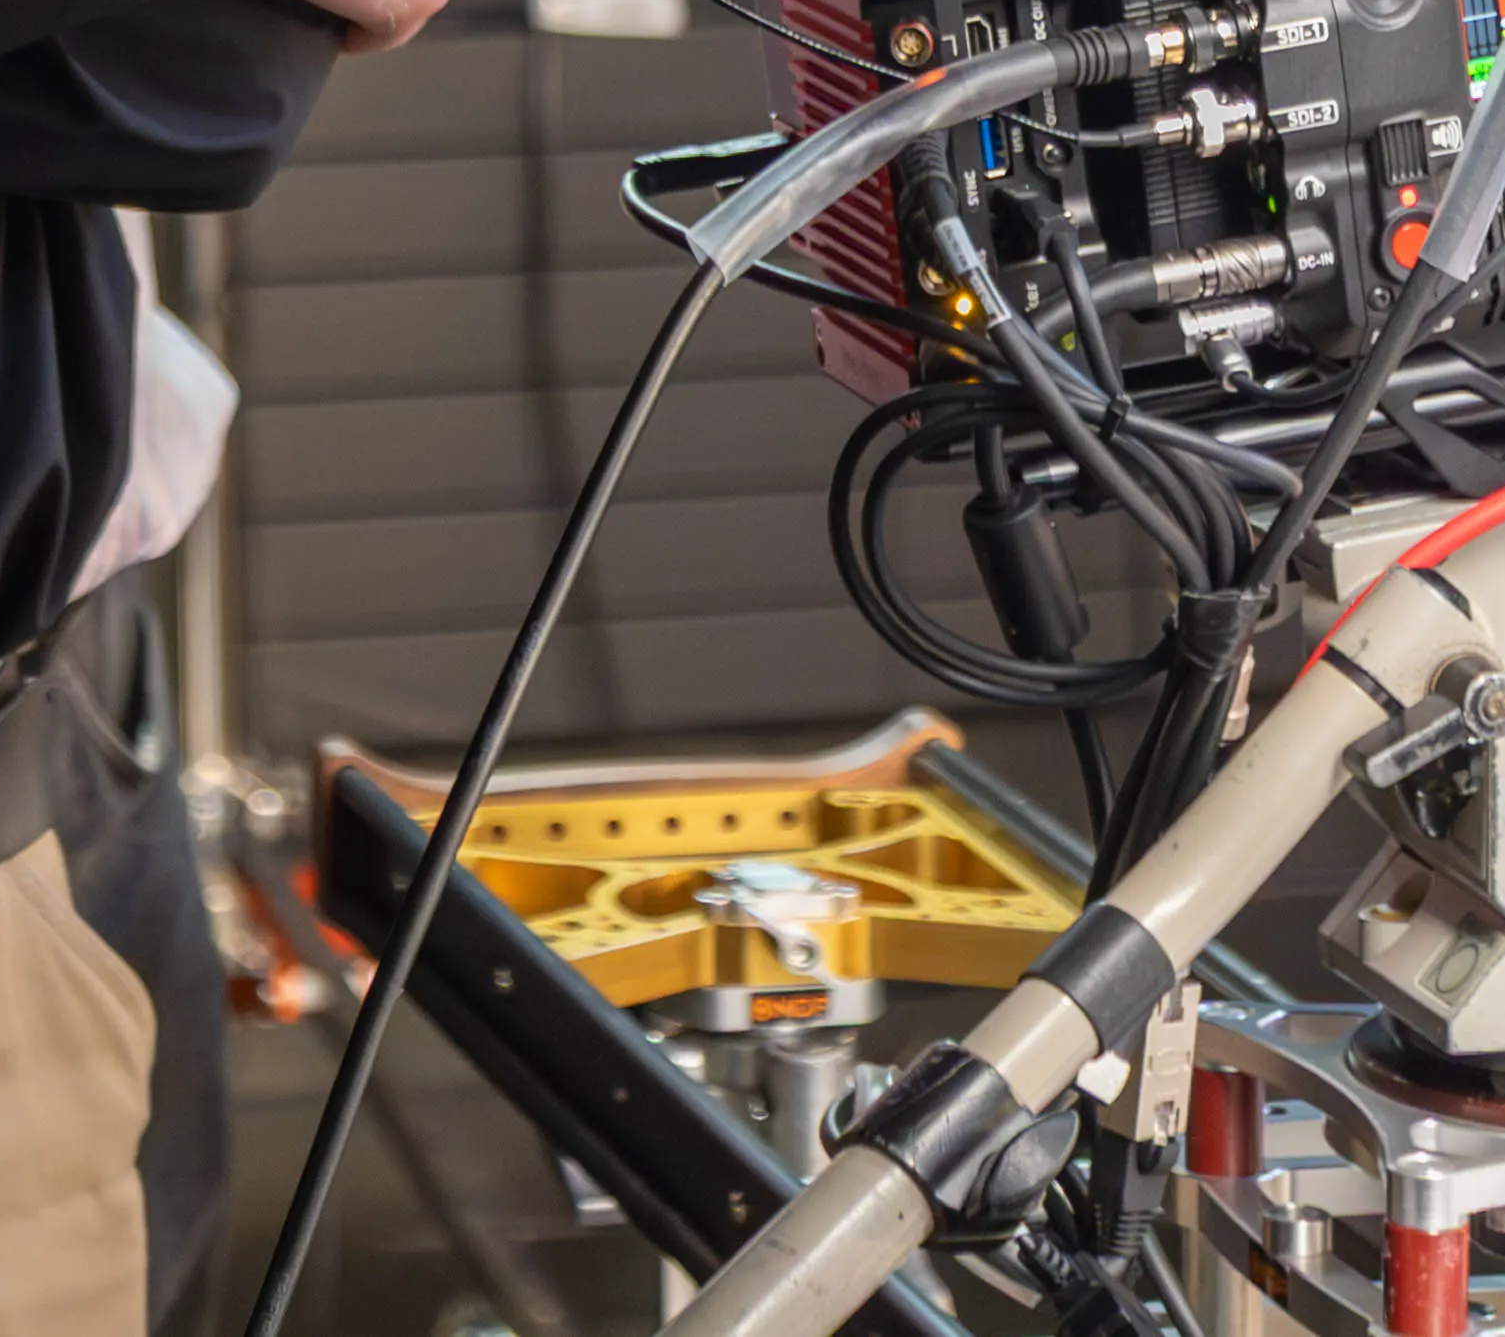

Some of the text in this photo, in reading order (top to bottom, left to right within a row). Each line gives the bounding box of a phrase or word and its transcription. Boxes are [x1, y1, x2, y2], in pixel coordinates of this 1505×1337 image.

[1277, 24, 1323, 45] SDI-1
[1287, 106, 1333, 127] SDI-2
[964, 169, 979, 207] SYNC
[1297, 251, 1335, 271] DC-IN
